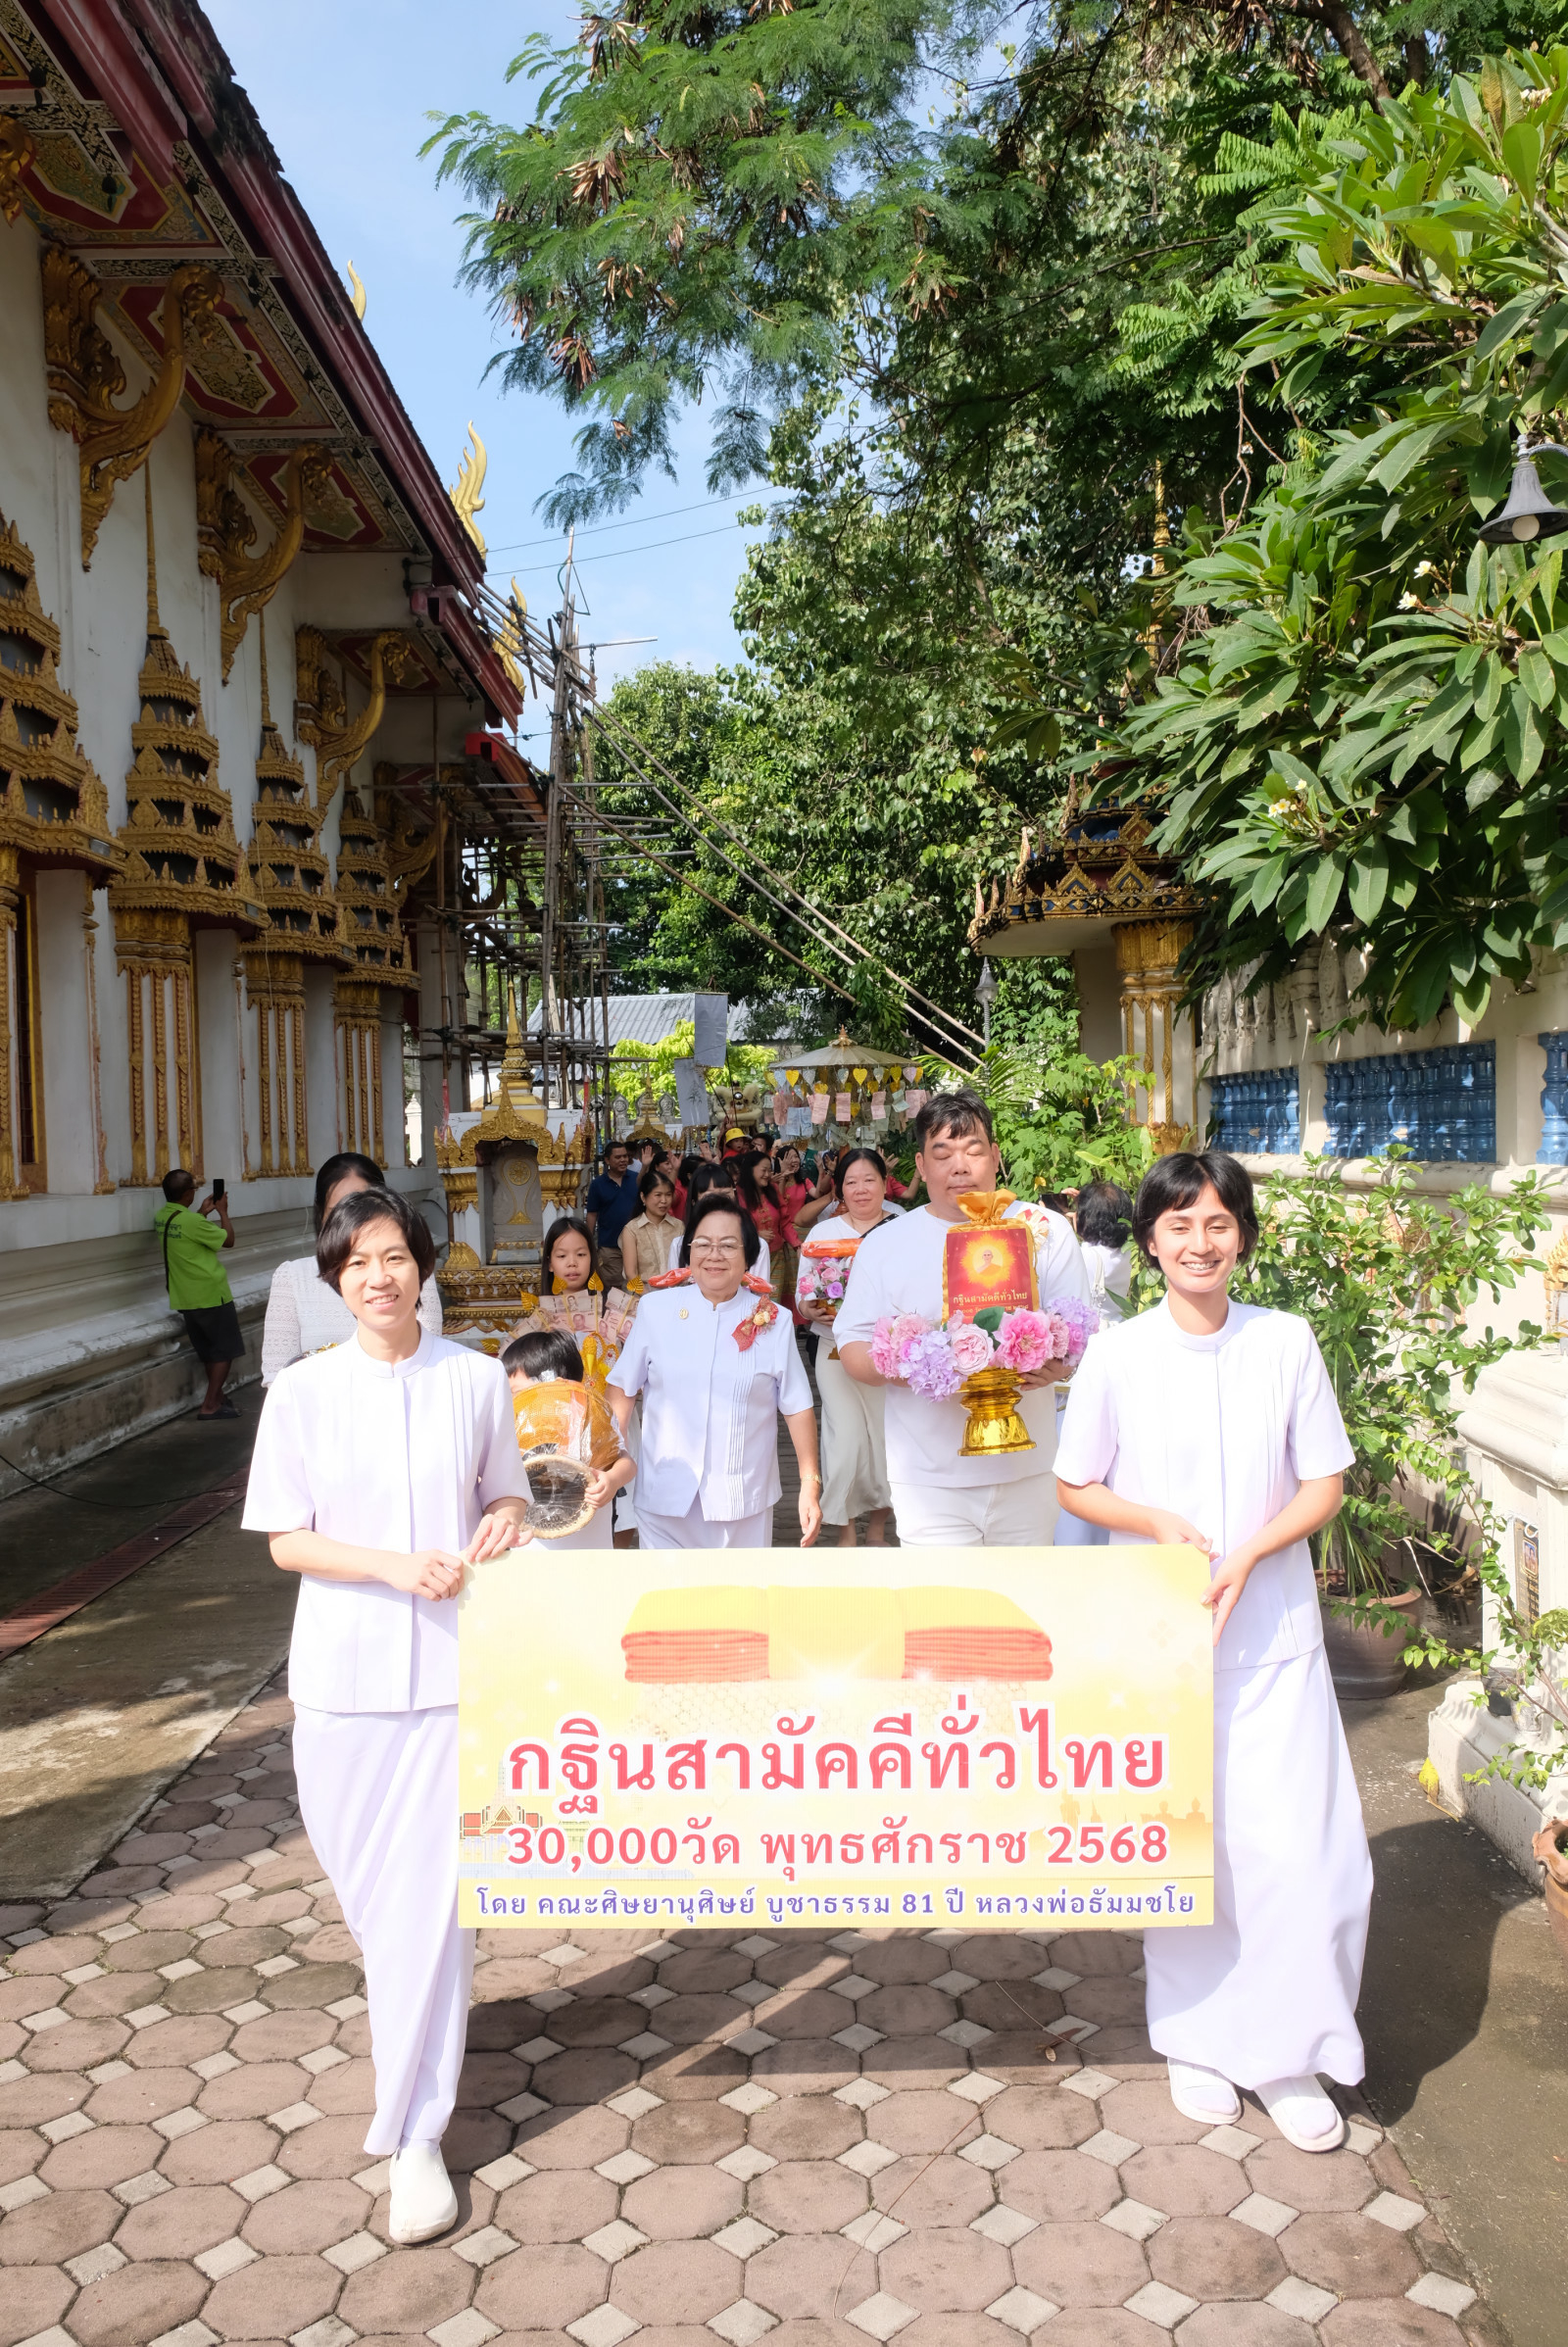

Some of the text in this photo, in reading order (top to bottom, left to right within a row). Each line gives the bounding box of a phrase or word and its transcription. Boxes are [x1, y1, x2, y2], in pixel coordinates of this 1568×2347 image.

[510, 1694, 1163, 1814] กฐินสามัคคีทั่วไทย
[760, 1816, 1026, 1882] พุทธศักราช
[1048, 1825, 1167, 1864] 2568
[476, 1884, 1194, 1924] โดย คณะศิษยานุศิษย์ บูชาธรรม 81 ปี หลวงพ่อธัมมชโย
